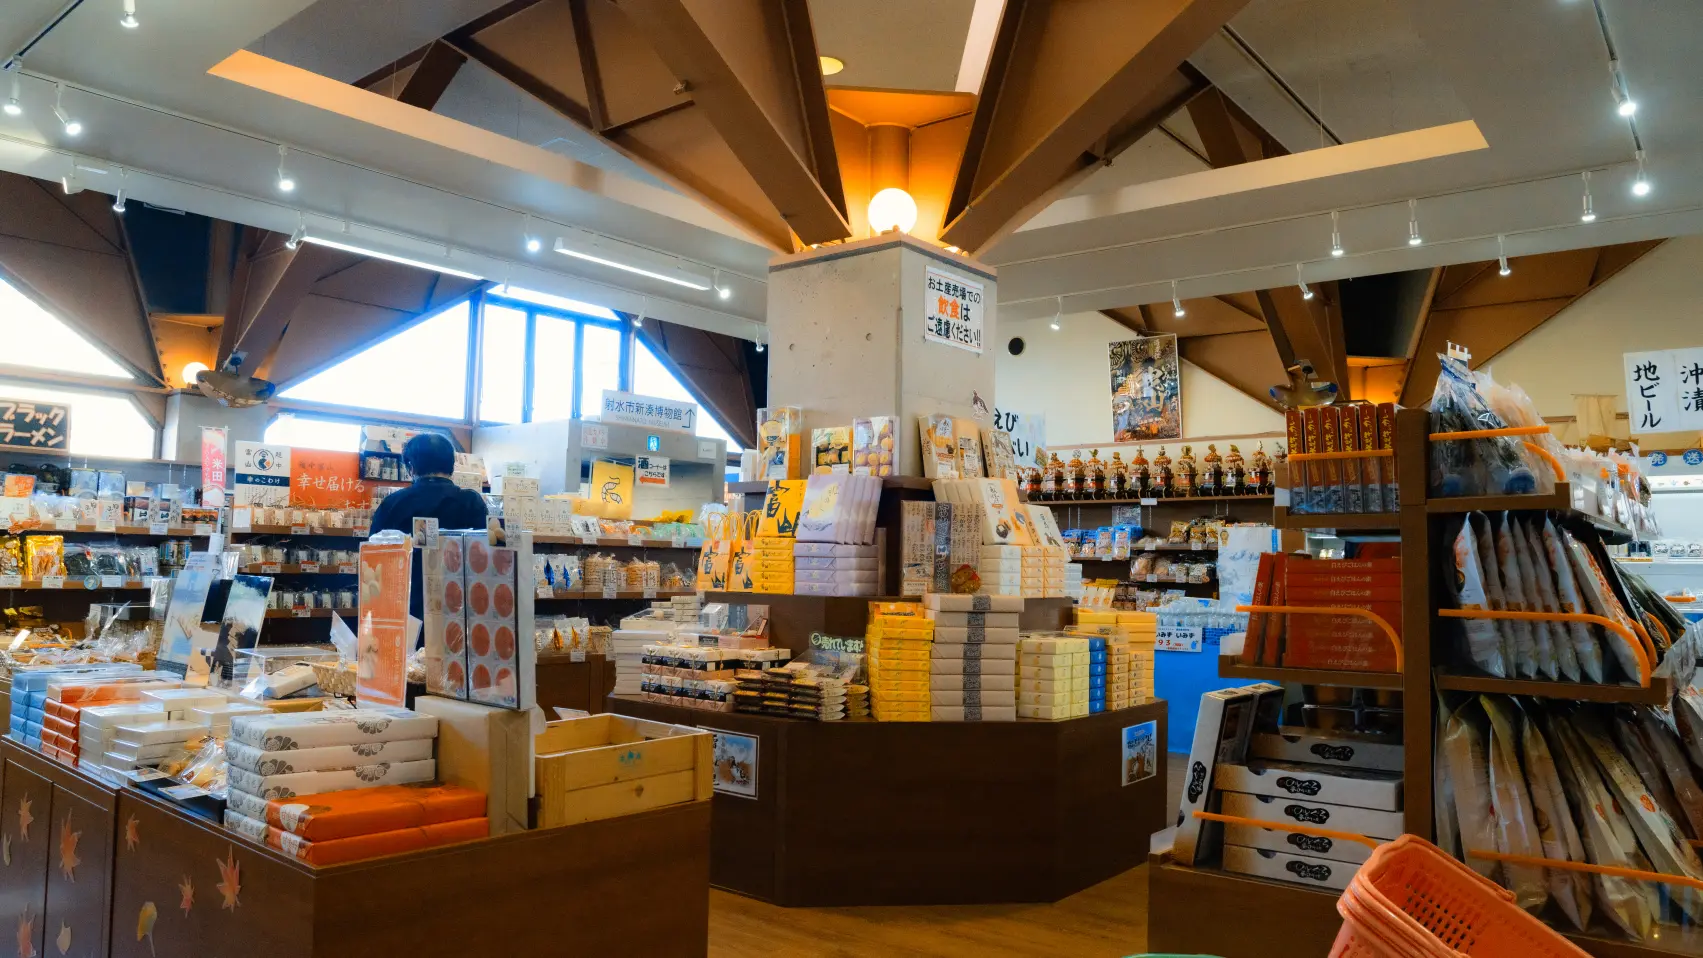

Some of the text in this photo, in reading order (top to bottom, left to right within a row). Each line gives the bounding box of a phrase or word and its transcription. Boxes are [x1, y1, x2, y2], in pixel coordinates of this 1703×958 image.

[928, 275, 981, 304] お土産売場での
[937, 295, 971, 322] 飲食は
[1633, 360, 1662, 428] 地ビール
[604, 397, 682, 421] 射水市新湊博物館
[994, 408, 1019, 432] えび
[0, 422, 64, 446] ラーメン
[211, 458, 223, 482] 米田
[297, 472, 365, 493] 幸せ届ける
